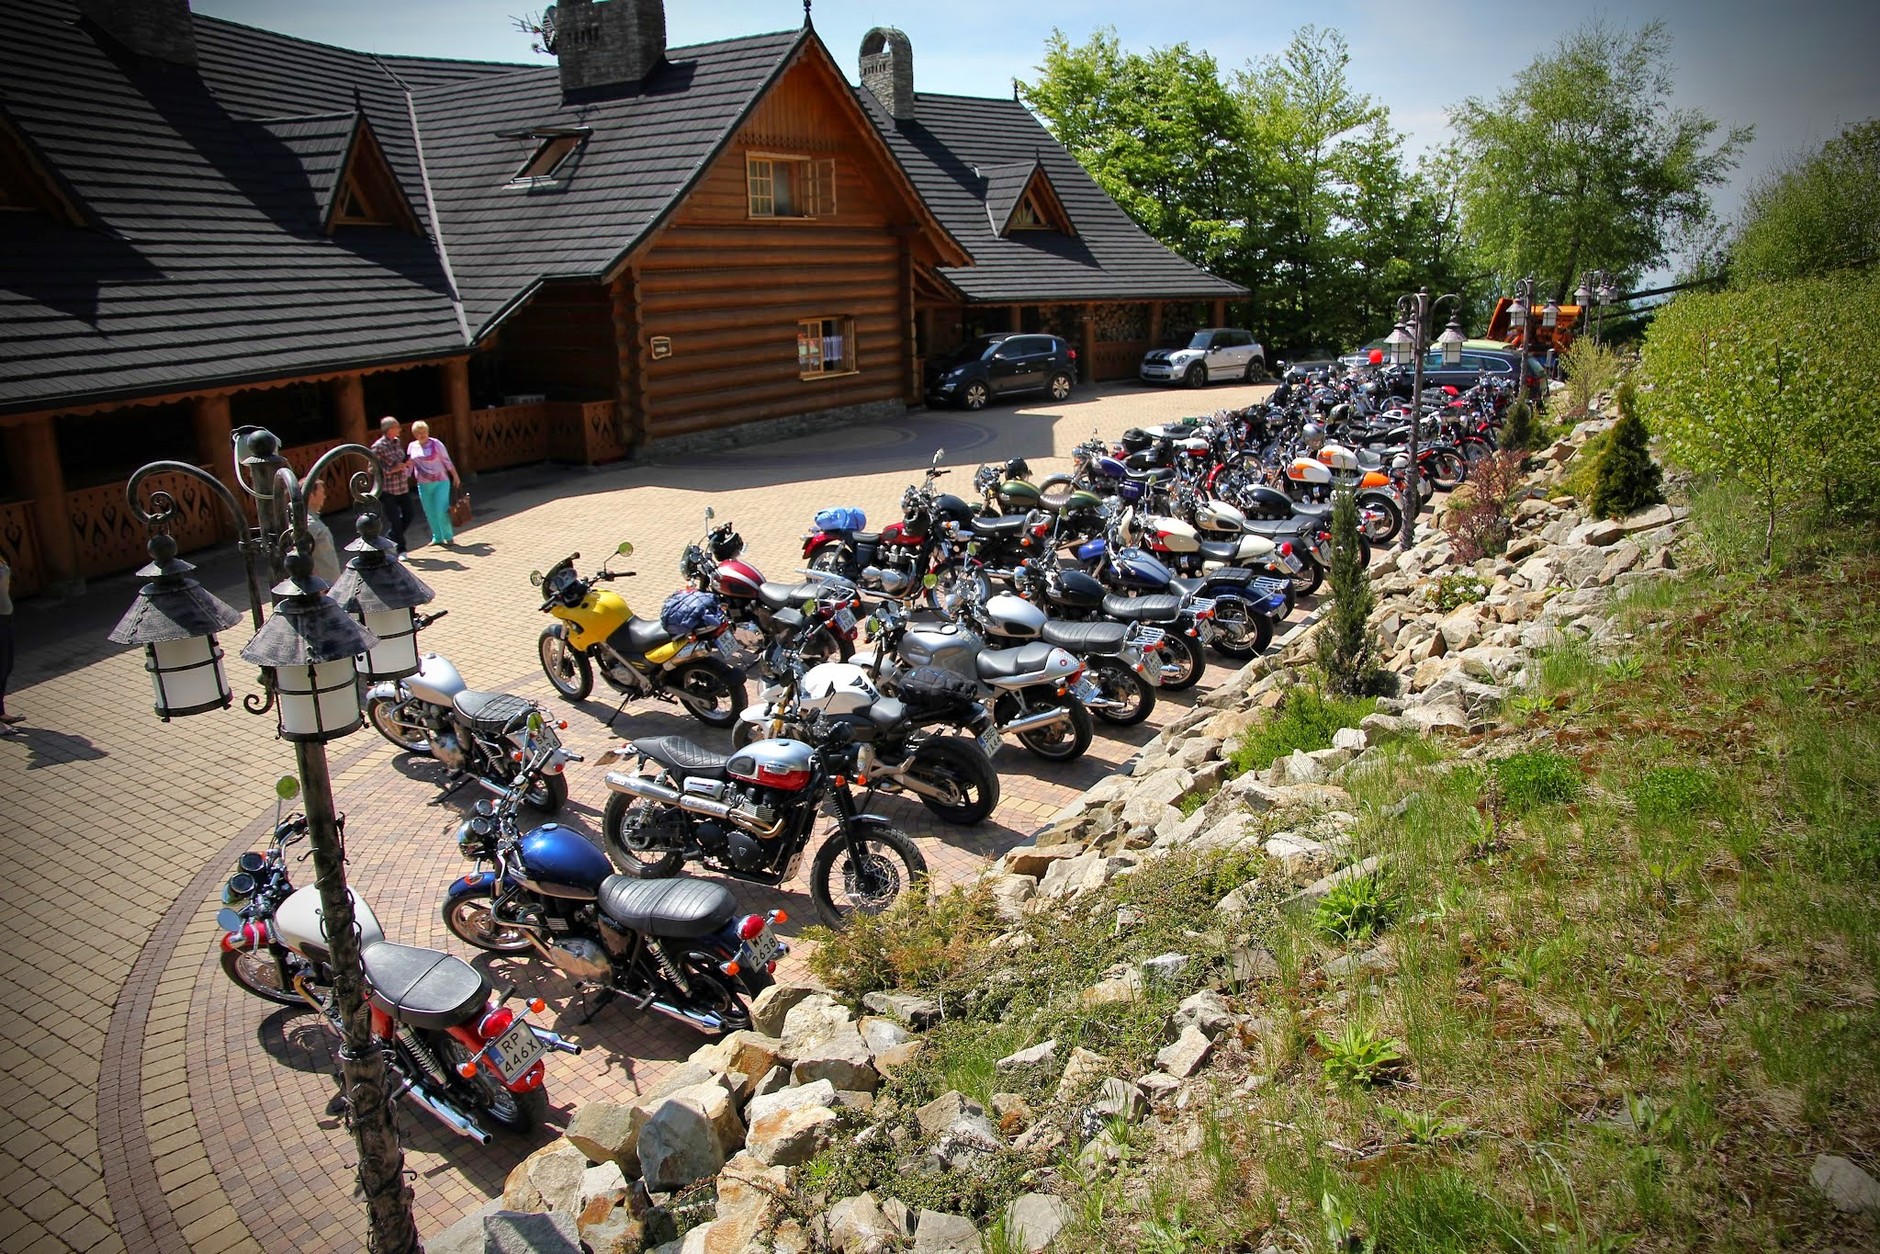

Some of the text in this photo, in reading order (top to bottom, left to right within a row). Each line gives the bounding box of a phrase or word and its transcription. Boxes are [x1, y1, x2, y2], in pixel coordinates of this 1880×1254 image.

[536, 732, 548, 745] SK
[983, 728, 995, 743] SBE
[752, 937, 776, 967] 2638
[501, 1032, 519, 1053] RP
[505, 1039, 537, 1073] 446X
